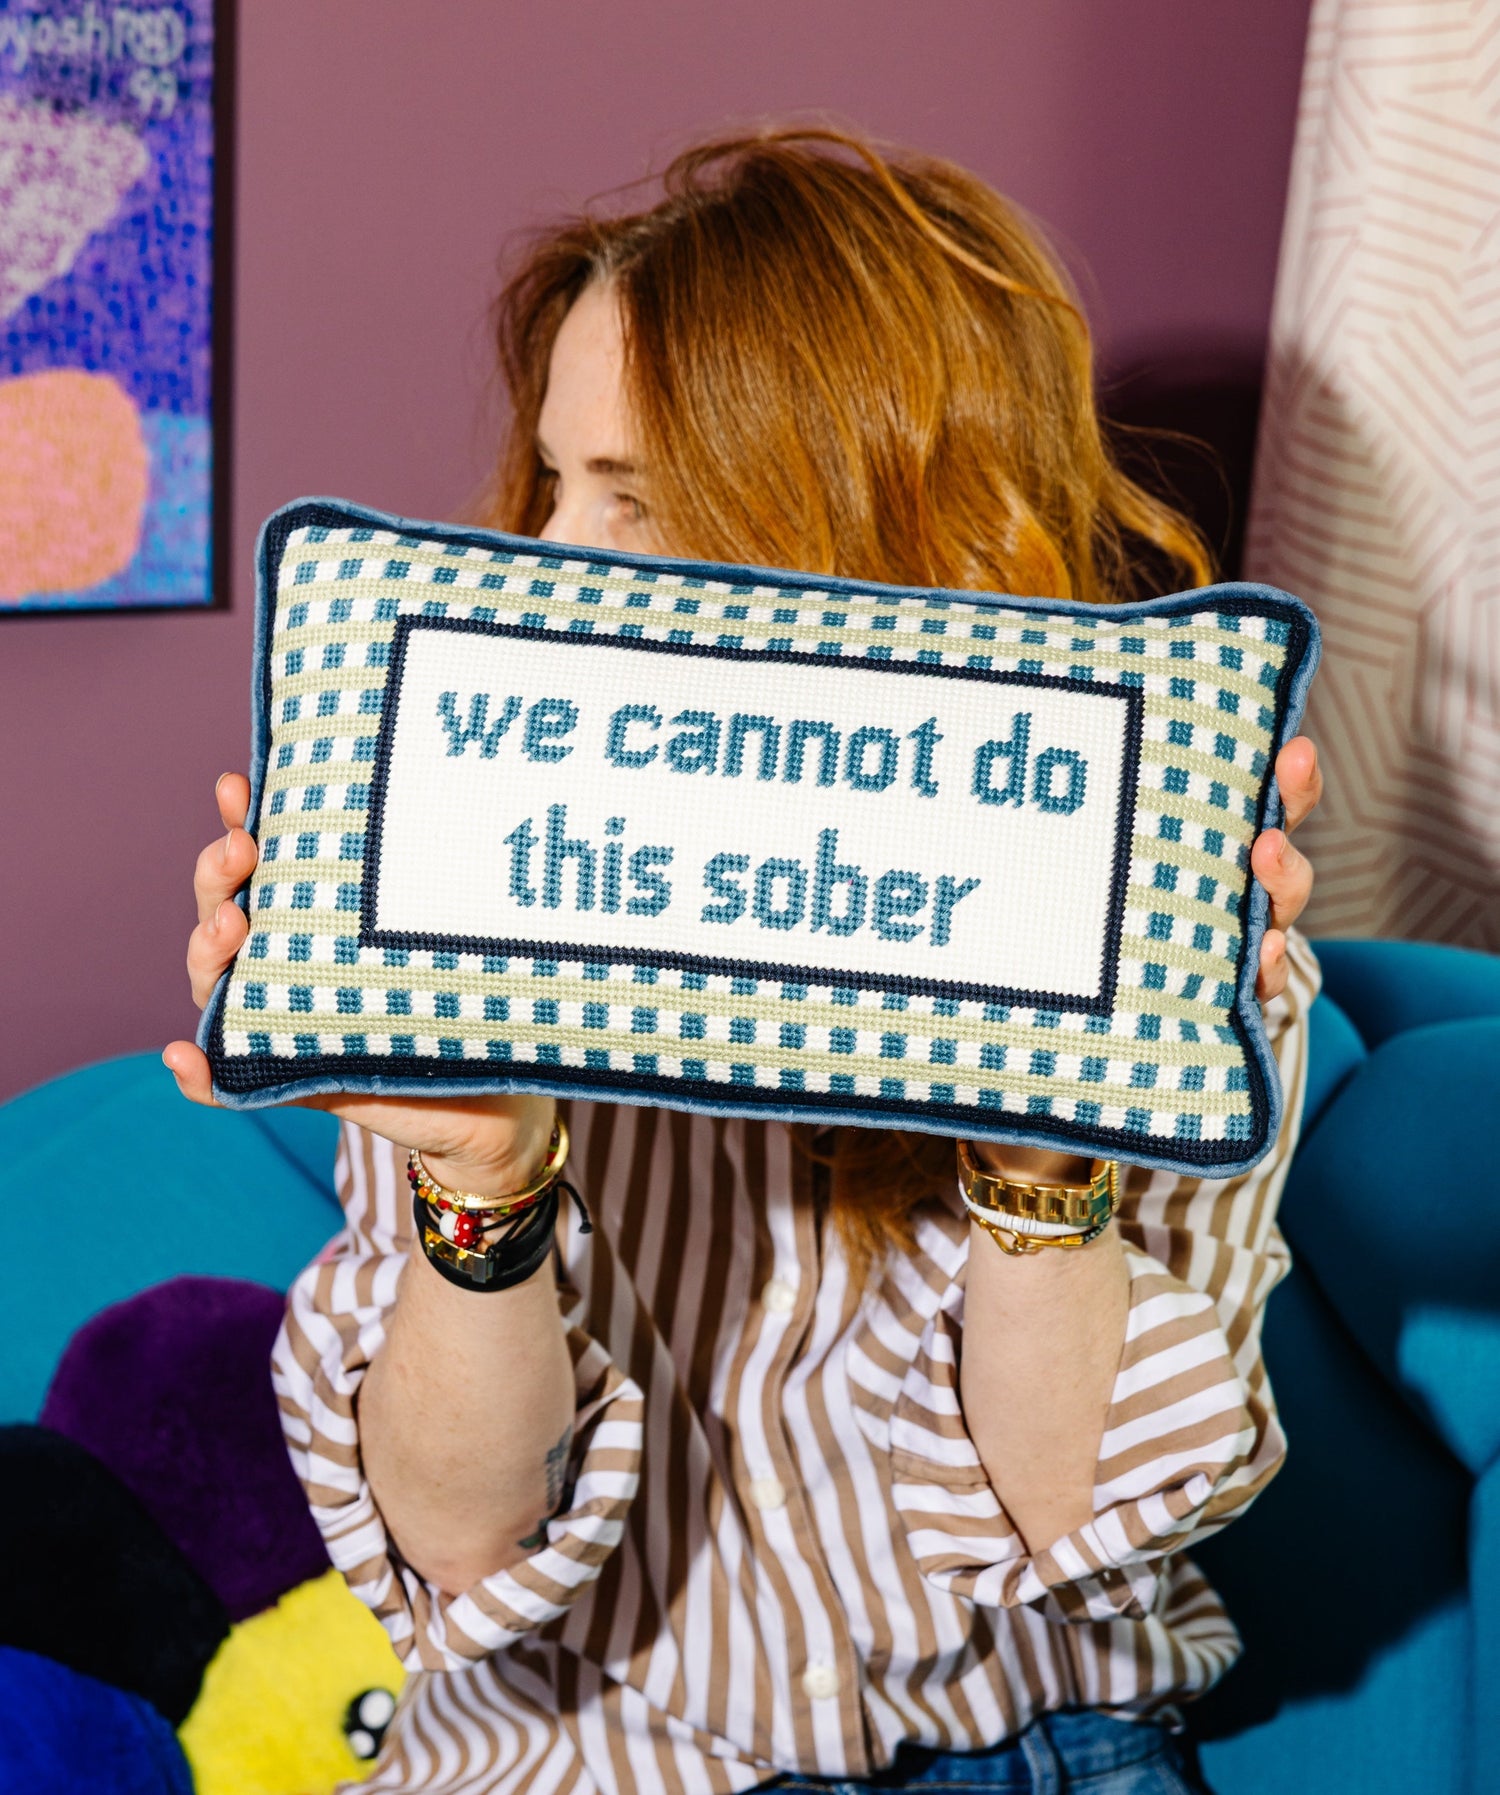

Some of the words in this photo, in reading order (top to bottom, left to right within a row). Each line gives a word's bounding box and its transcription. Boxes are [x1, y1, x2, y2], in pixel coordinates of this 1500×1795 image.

[436, 691, 580, 764] we
[604, 703, 945, 799] cannot
[970, 711, 1089, 817] do
[503, 803, 675, 918] this
[700, 827, 982, 947] sober
